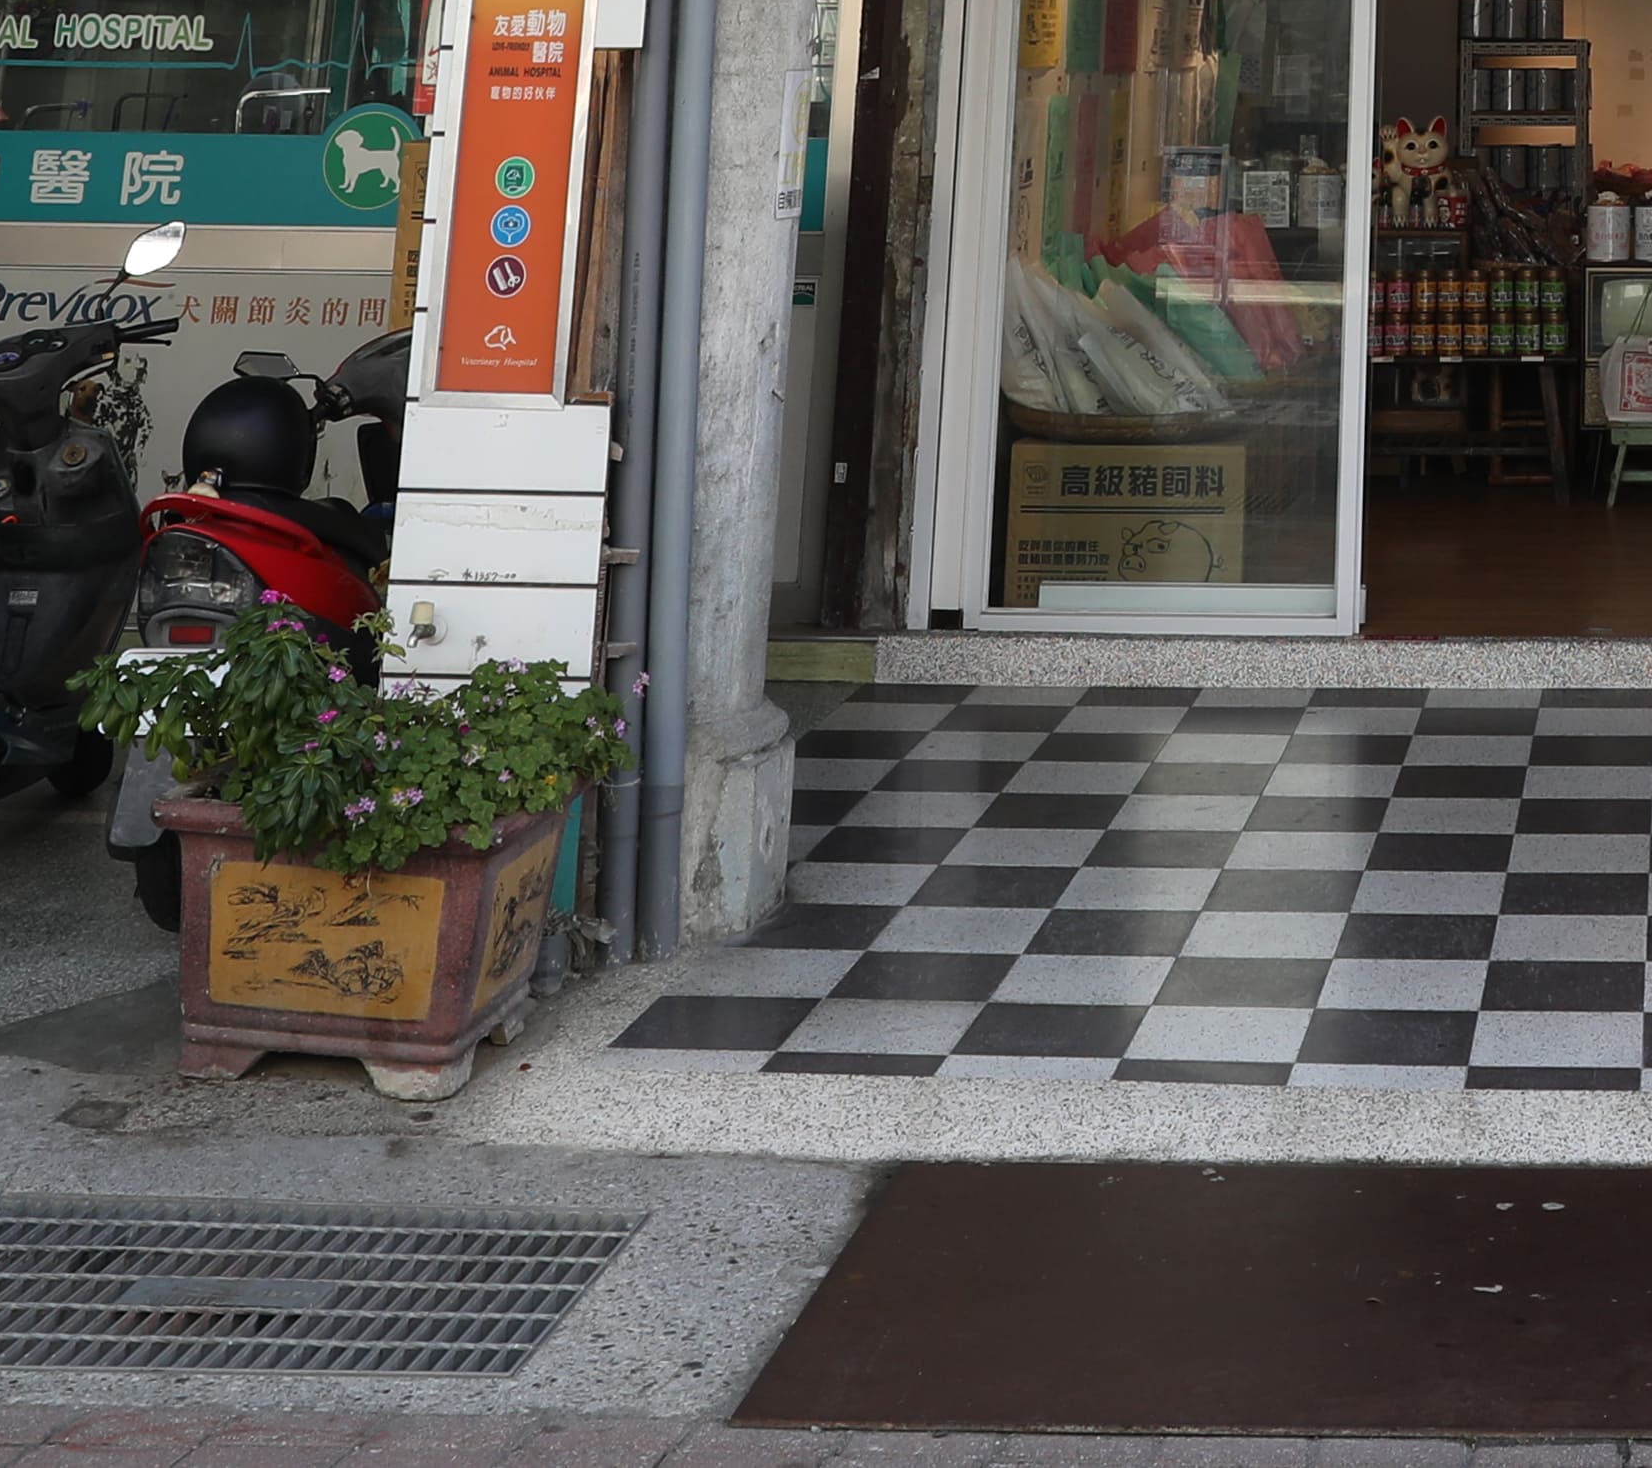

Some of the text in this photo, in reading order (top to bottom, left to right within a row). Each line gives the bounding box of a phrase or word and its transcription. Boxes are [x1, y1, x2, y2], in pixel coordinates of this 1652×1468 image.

[53, 13, 215, 53] HOSPITAL
[493, 9, 567, 37] 友愛動物
[532, 41, 564, 63] 醫院
[177, 294, 389, 328] 犬關節炎的問
[1060, 465, 1225, 497] 高級豬飼料
